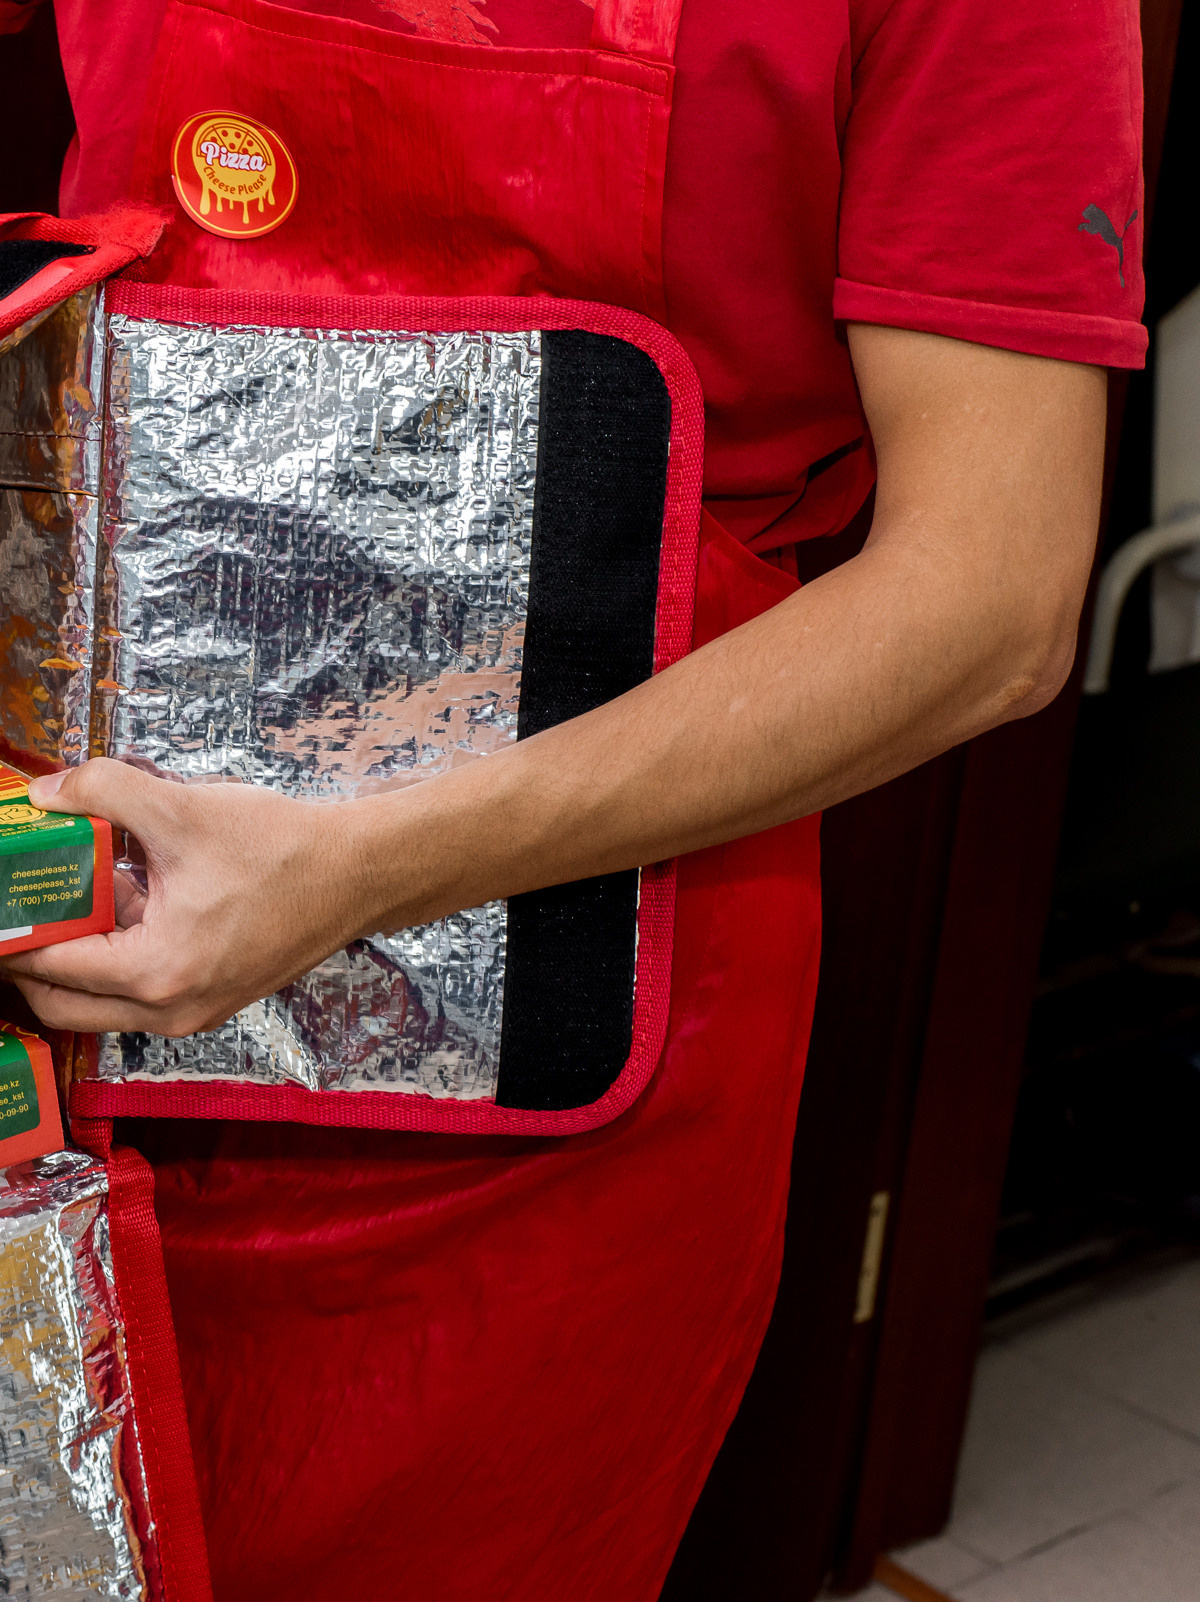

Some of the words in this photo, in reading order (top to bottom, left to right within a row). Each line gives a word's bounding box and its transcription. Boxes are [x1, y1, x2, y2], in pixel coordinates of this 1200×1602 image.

[201, 141, 267, 172] Pizza
[204, 166, 236, 195] Cheese
[237, 173, 267, 195] Please
[11, 863, 79, 879] cheeseplease.kz
[8, 876, 81, 894] cheeseplease_kst
[6, 897, 17, 907] +7
[18, 896, 41, 908] (700)
[42, 889, 83, 904] 790-09-90
